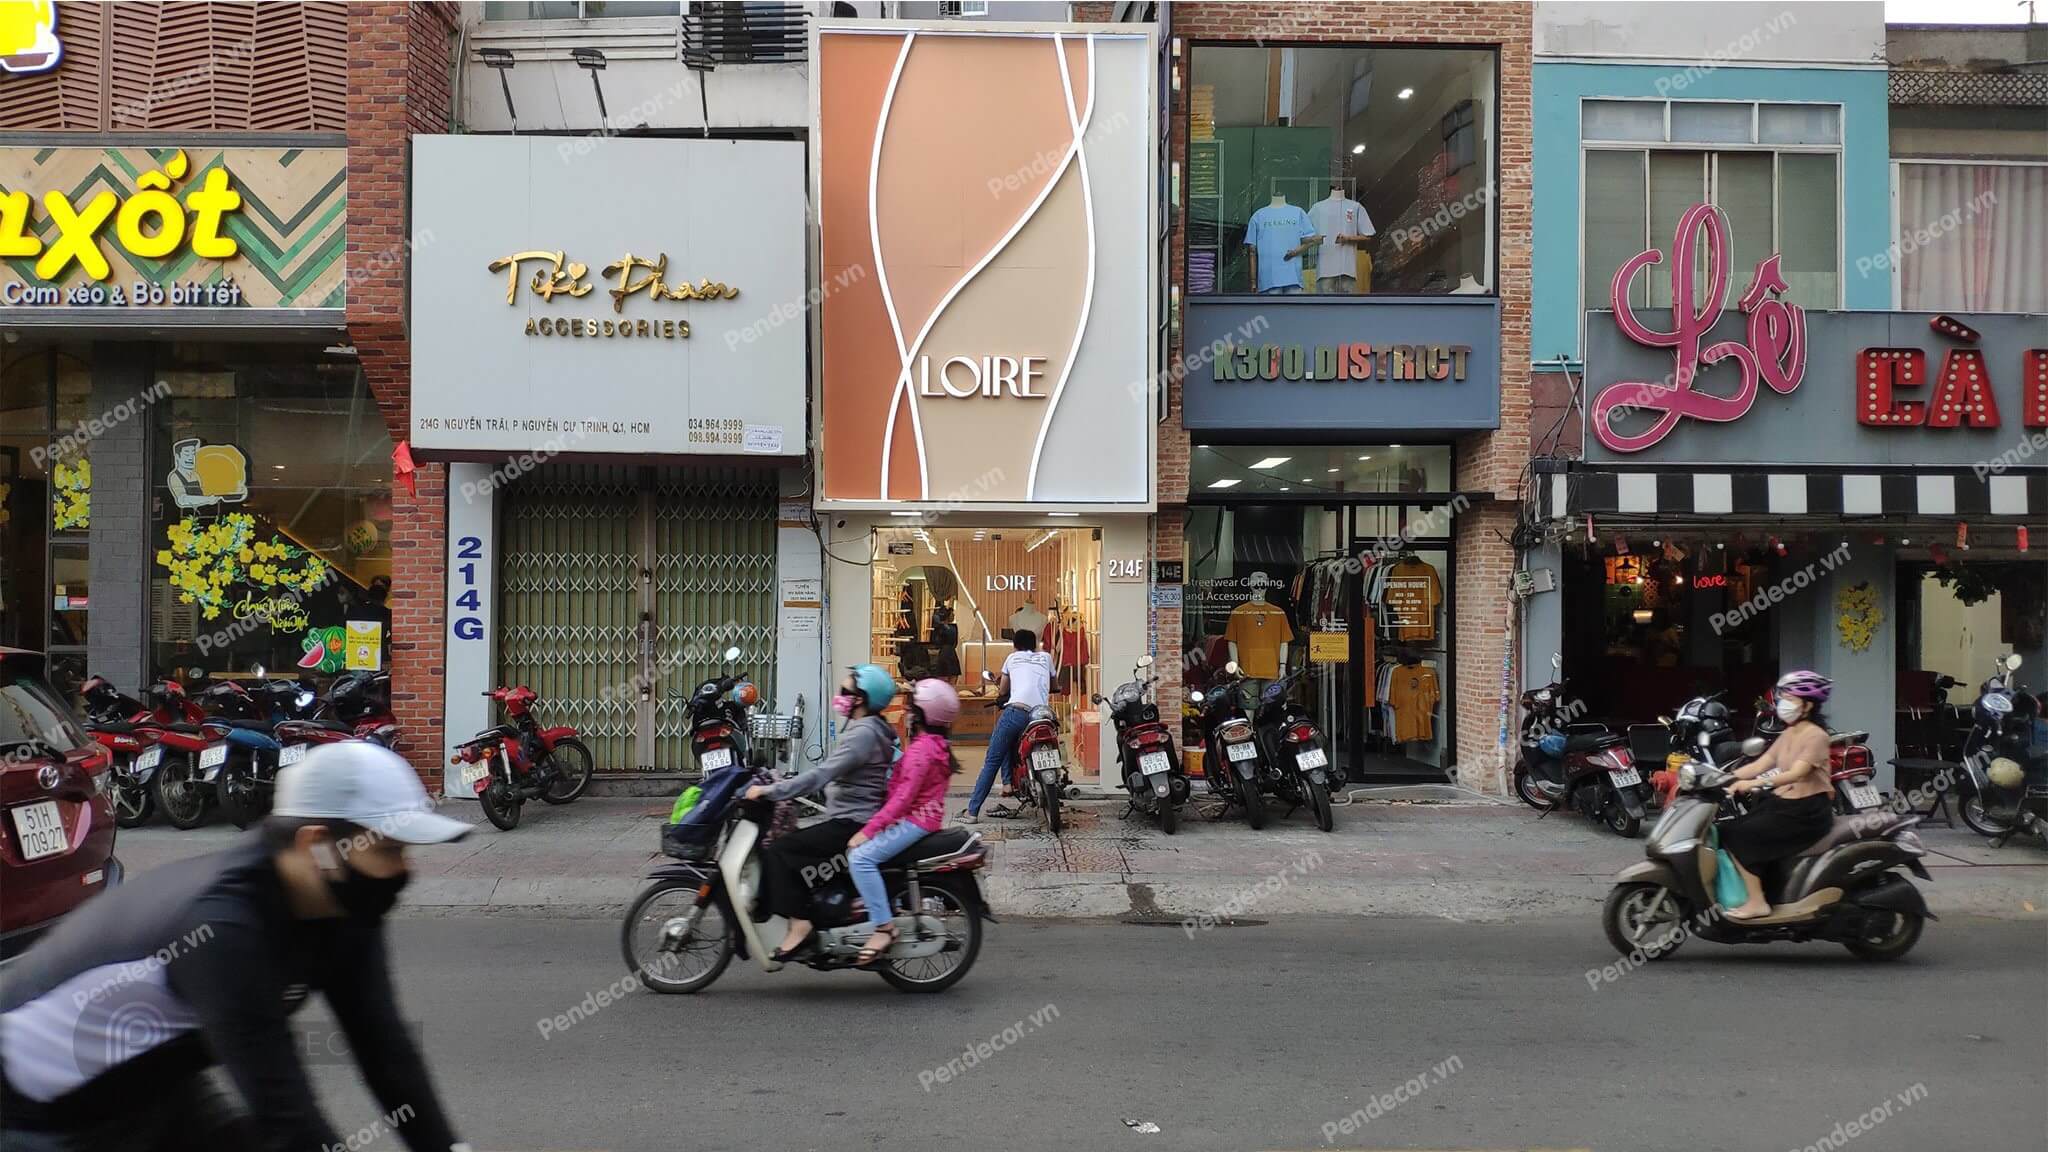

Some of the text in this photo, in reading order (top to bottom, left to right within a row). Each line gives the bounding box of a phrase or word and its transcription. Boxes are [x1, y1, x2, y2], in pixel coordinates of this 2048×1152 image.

[3, 275, 241, 305] Cơm xèo & Bò bít tết
[524, 317, 692, 339] ACCESSORIES
[1213, 344, 1471, 381] K300.DISTRICT
[1856, 315, 2001, 428] CÀ
[921, 355, 1048, 398] LOIRE
[420, 418, 439, 430] 214G
[581, 421, 610, 434] TRINH,
[630, 422, 650, 434] HCM
[688, 418, 743, 430] 034.964.9999
[1108, 559, 1143, 577] 214F
[454, 536, 484, 640] 214G
[986, 574, 1037, 591] LOIRE
[1240, 577, 1285, 589] Clothing,
[1185, 591, 1204, 601] and
[1206, 591, 1265, 601] Accessories.
[24, 805, 52, 829] 51H
